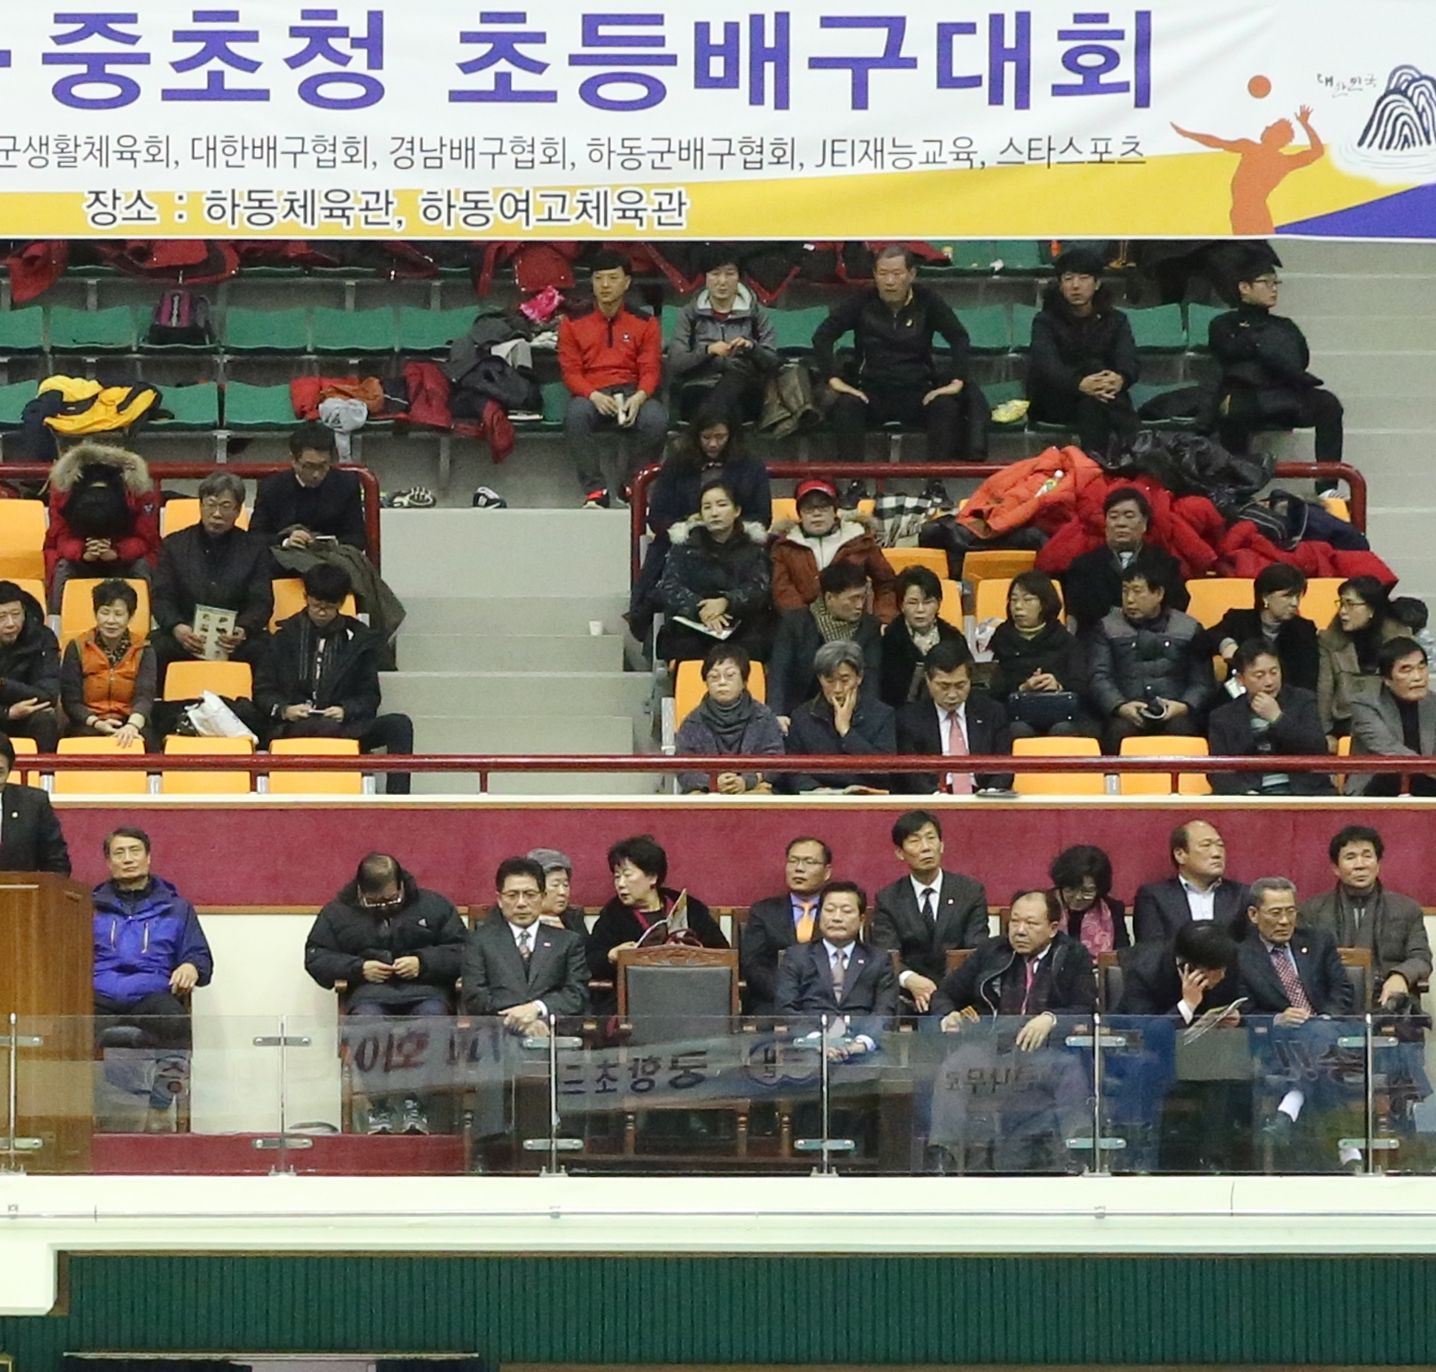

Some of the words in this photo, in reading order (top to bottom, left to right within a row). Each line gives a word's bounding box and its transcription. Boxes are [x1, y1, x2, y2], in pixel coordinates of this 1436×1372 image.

[448, 9, 1153, 112] 초등배구대회
[189, 134, 378, 171] 대한배구협회,
[388, 135, 577, 171] 경남배구협회,
[586, 135, 805, 171] 하동군배구협회,
[814, 136, 986, 171] JEI재능교육,
[995, 136, 1147, 170] 스타스포츠
[85, 188, 159, 228] 장소
[204, 188, 403, 229] 하동체육관,
[421, 188, 689, 229] 하동여고체육관
